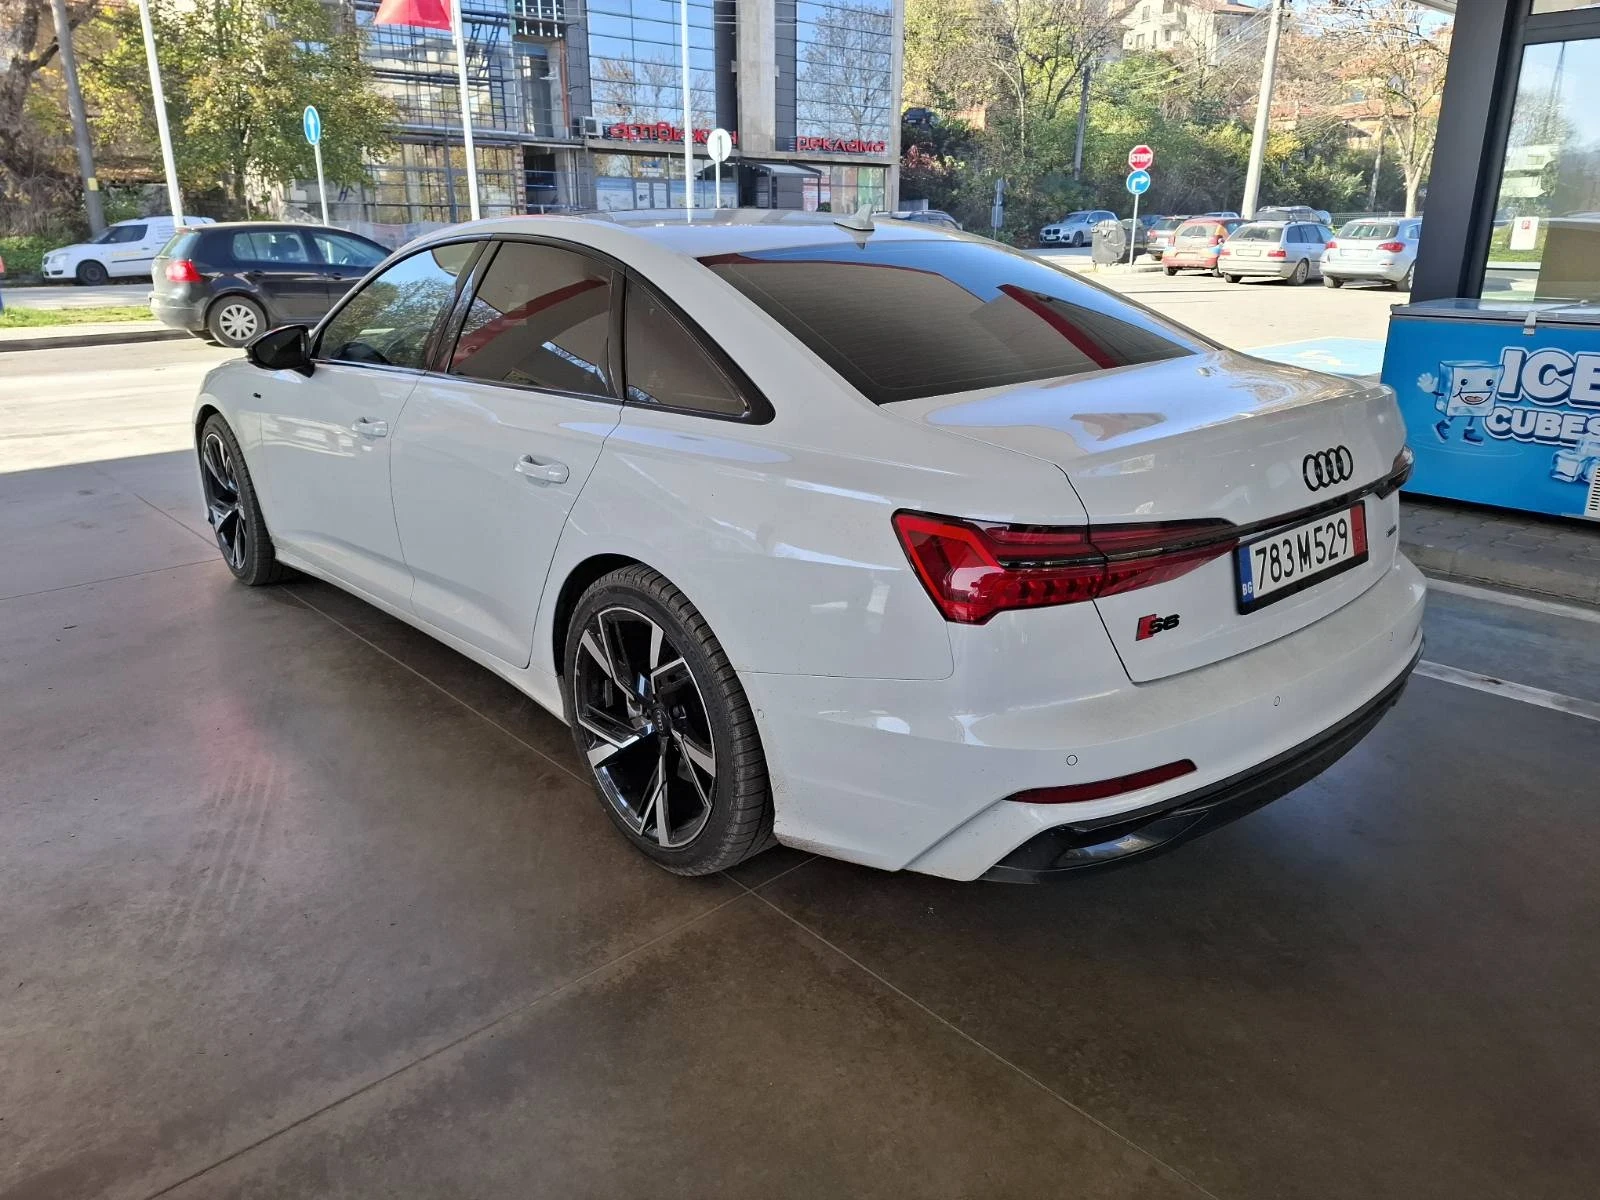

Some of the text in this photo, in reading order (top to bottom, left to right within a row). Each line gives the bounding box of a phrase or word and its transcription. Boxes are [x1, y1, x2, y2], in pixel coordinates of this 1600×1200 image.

[1131, 153, 1151, 163] STOP
[1498, 348, 1600, 404] ICE
[1242, 581, 1253, 596] BG
